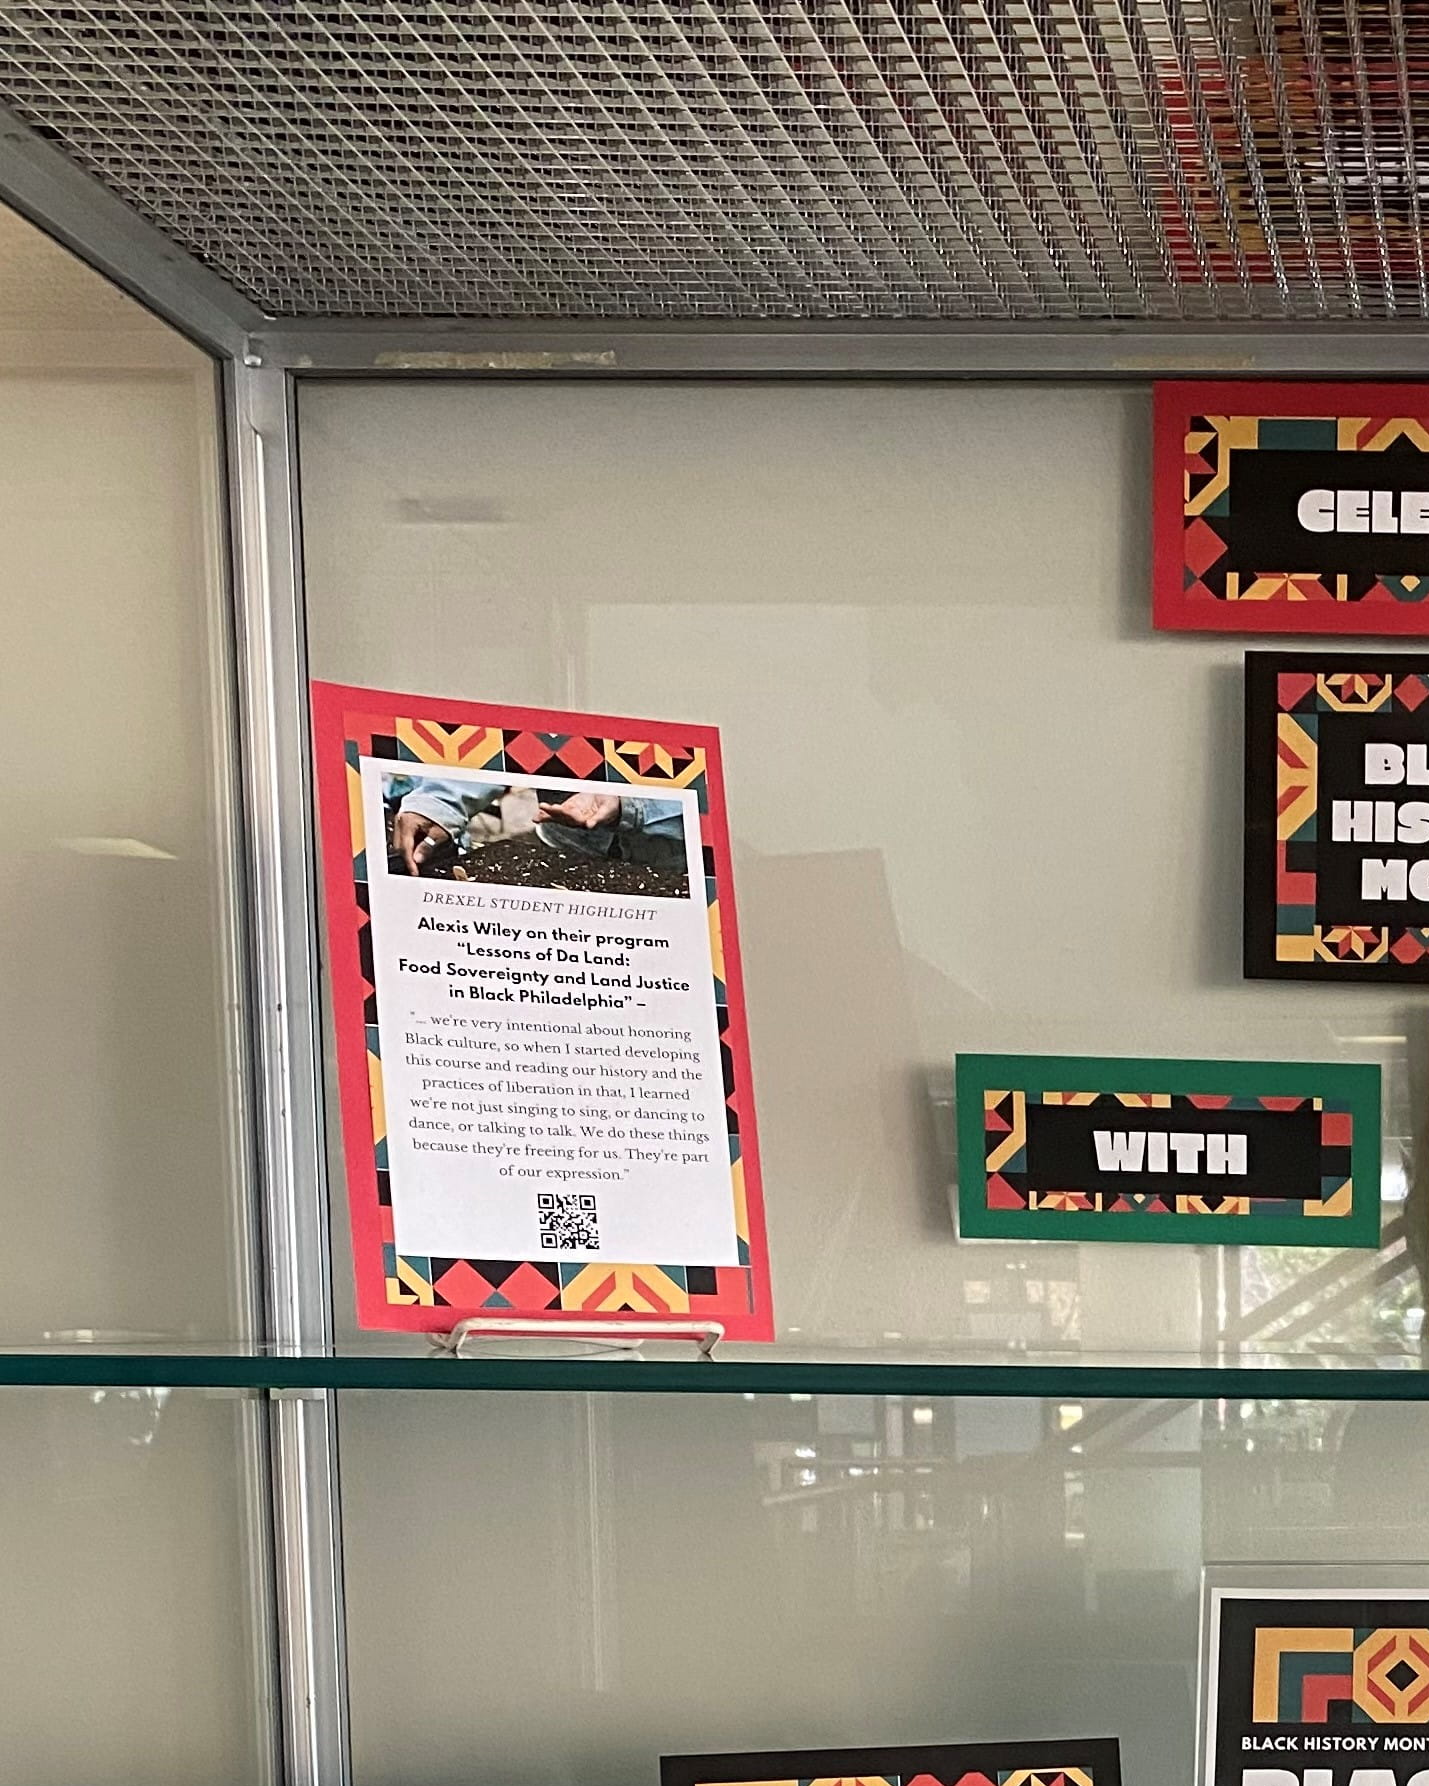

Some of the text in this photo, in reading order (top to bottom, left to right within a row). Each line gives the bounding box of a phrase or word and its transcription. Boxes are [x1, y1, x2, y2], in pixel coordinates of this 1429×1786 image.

[422, 891, 657, 920] DREXEL STUDENT HIGHLIGHT
[416, 916, 669, 950] Alexis Wiley on their program
[456, 941, 630, 967] “Lessons of Da Land:
[398, 957, 690, 991] Food Sovereignty and Land Justice
[448, 983, 465, 998] in
[468, 984, 515, 1002] Black
[518, 988, 632, 1011] Philadelphia”
[1092, 1130, 1248, 1175] WITH
[1241, 1735, 1298, 1750] BLACK
[1303, 1736, 1379, 1751] HISTORY
